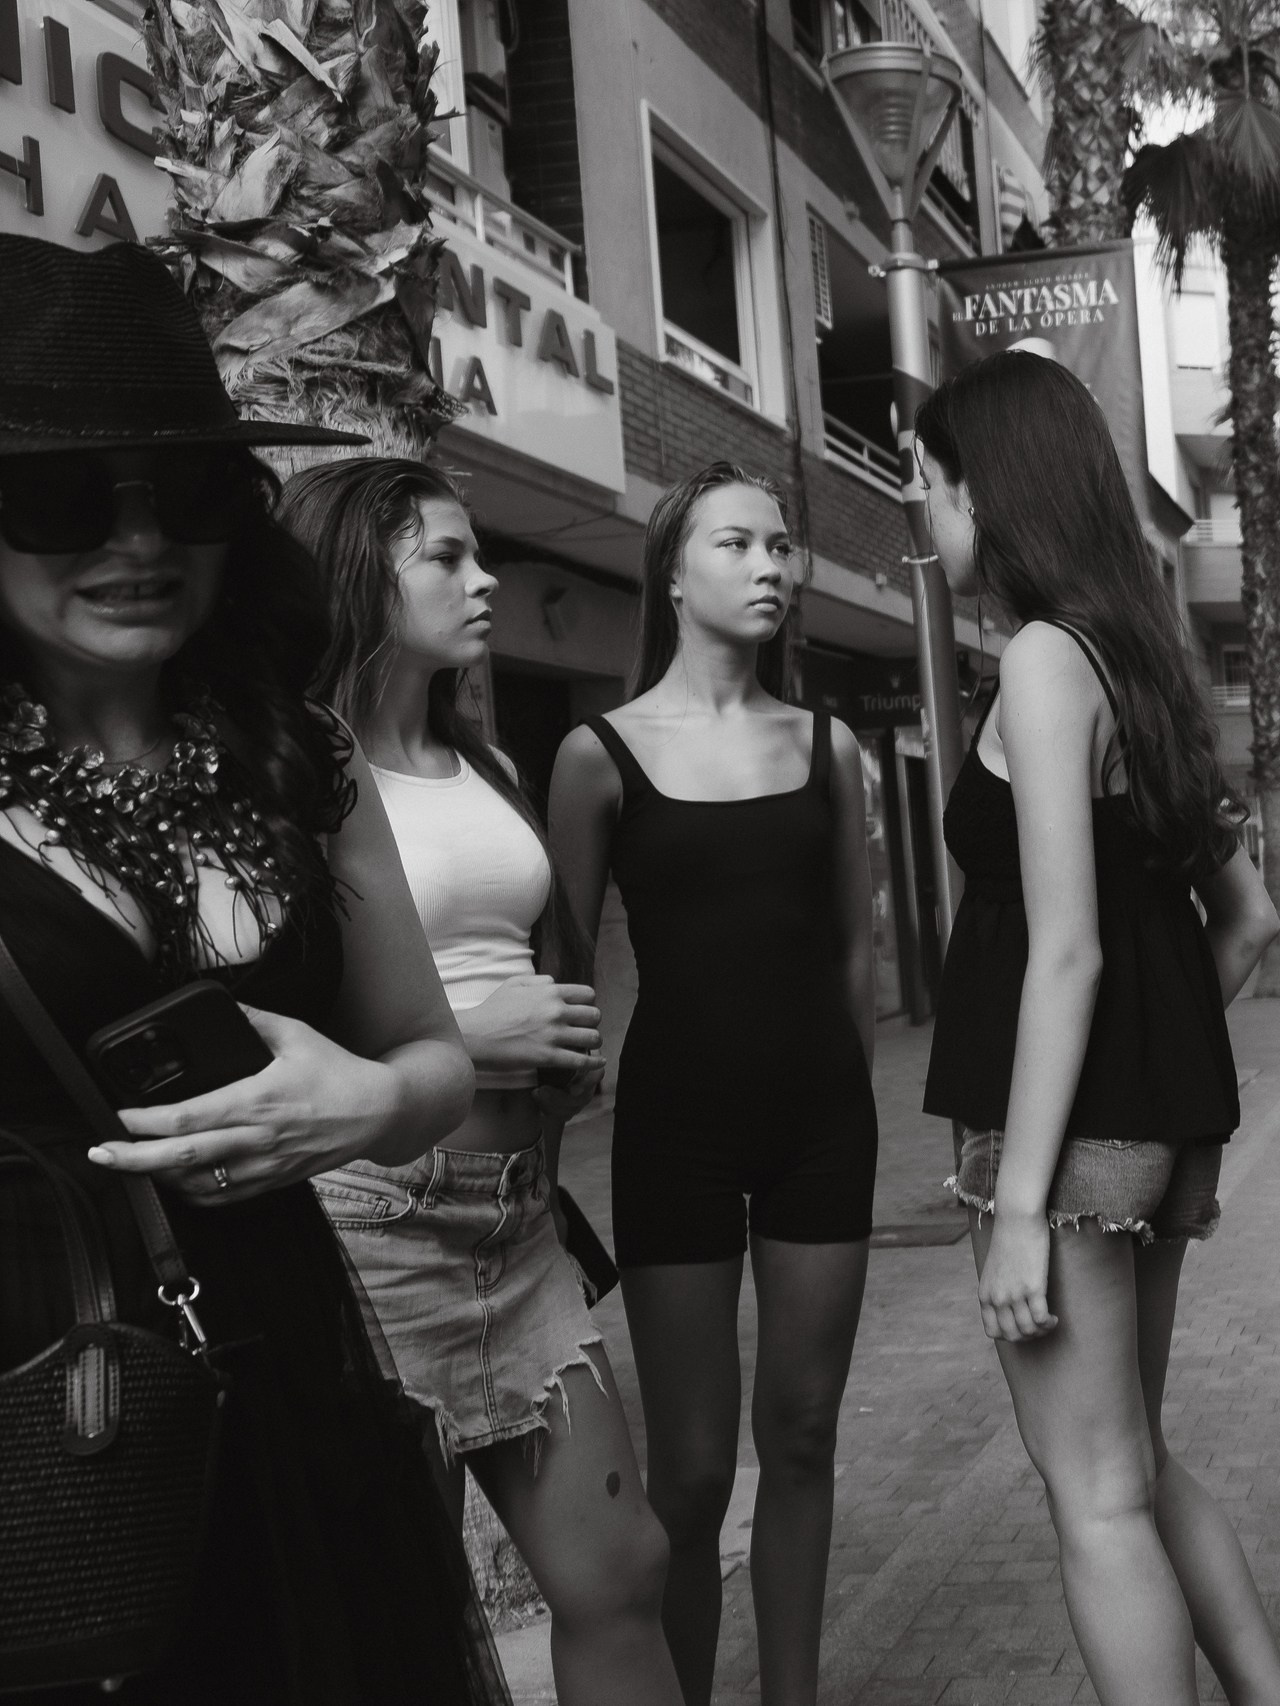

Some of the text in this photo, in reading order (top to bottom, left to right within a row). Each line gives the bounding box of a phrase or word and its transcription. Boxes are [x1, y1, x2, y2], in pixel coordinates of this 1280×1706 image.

[1055, 272, 1089, 282] WEBBER
[952, 278, 1119, 322] EL FANTASMA
[437, 247, 615, 396] NTAL
[975, 309, 1105, 337] DE LA ÓPERA
[861, 694, 922, 711] Triump
